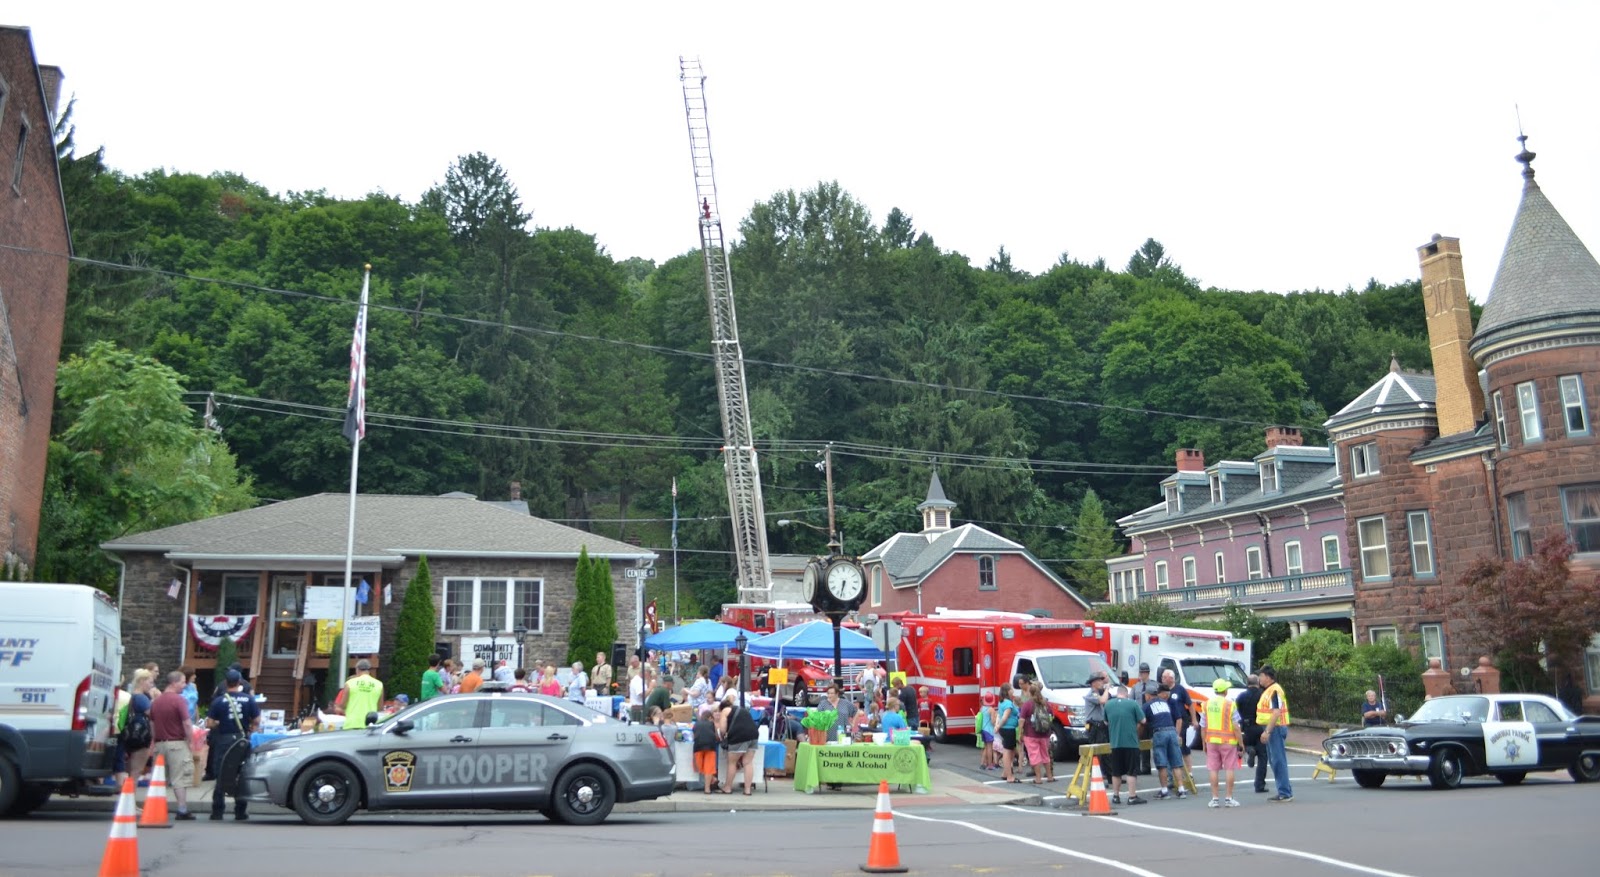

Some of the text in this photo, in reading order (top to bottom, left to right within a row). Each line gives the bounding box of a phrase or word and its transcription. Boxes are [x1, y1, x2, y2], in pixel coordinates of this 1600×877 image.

[627, 569, 648, 578] CENTRE
[21, 692, 46, 702] 911
[616, 732, 626, 742] L3
[1490, 729, 1530, 744] HIGHWAY PATROL
[818, 750, 892, 760] Schuylkill County
[424, 754, 547, 784] TROOPER
[822, 760, 844, 769] Drug
[856, 761, 887, 769] Alcohol
